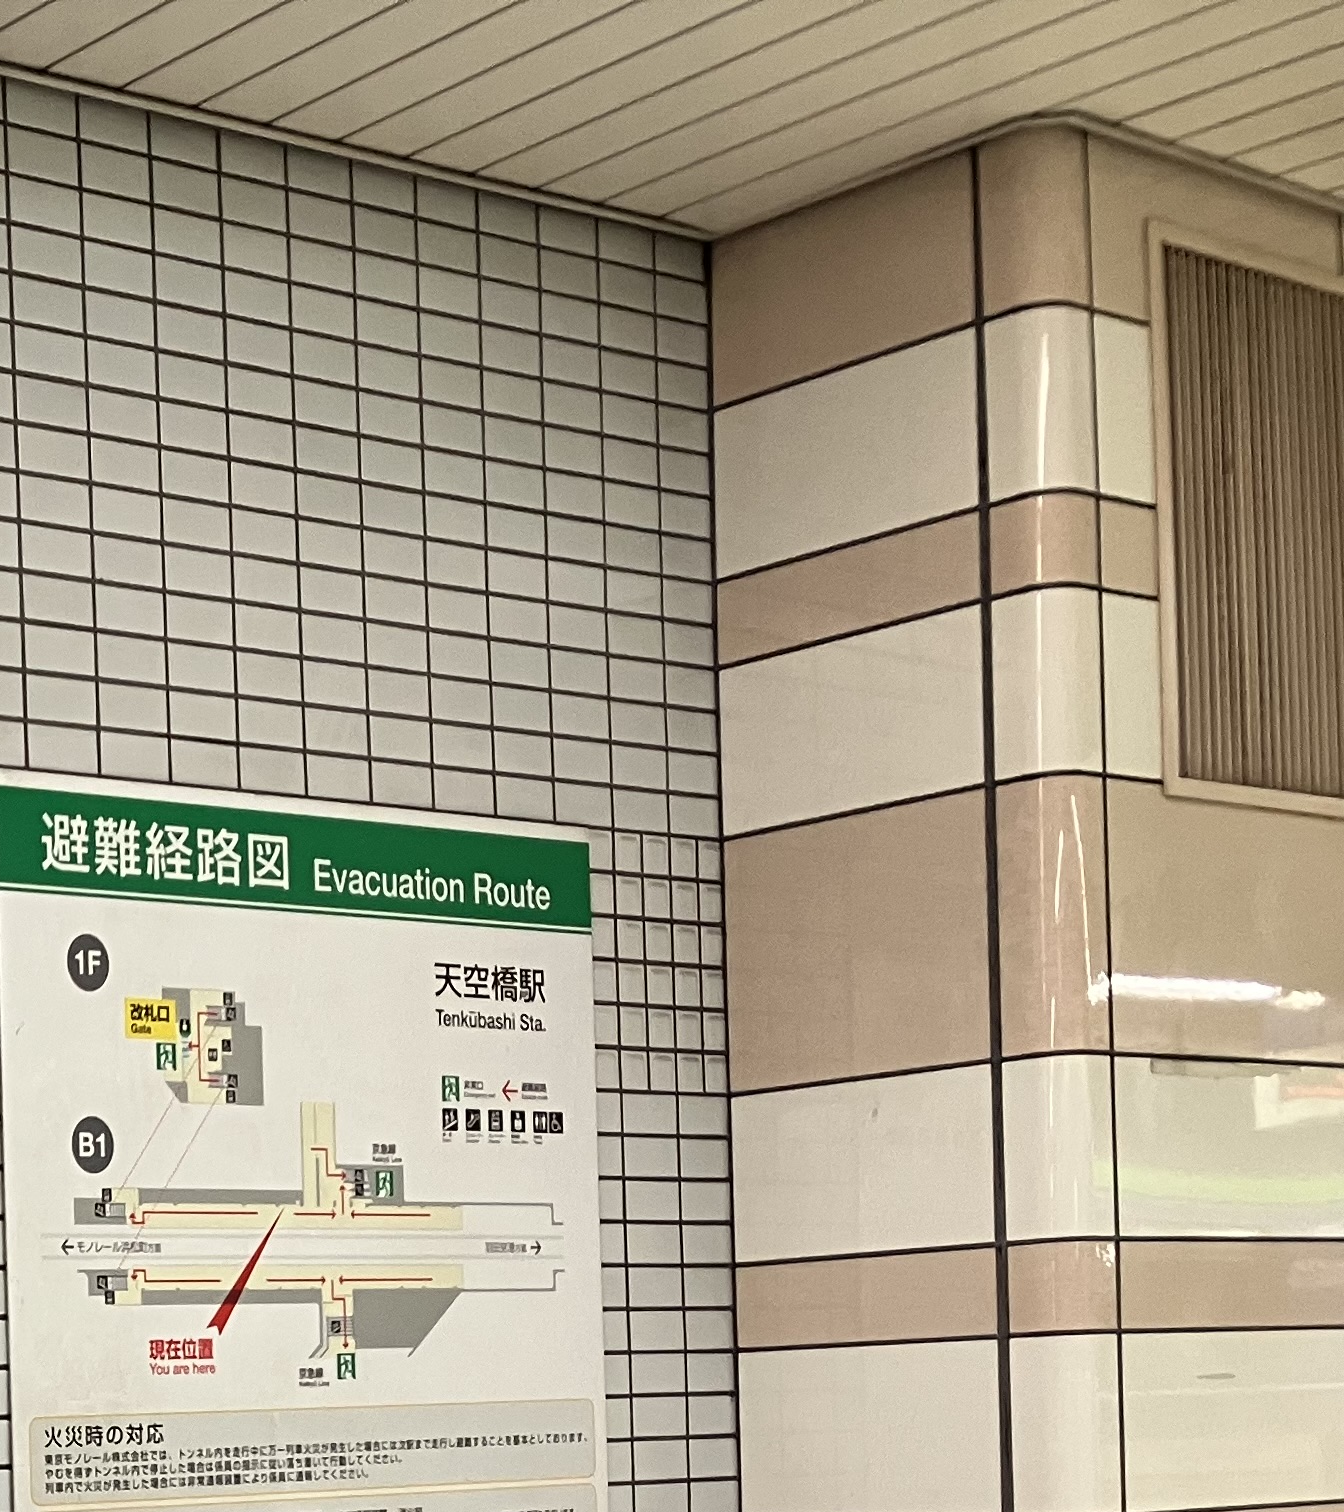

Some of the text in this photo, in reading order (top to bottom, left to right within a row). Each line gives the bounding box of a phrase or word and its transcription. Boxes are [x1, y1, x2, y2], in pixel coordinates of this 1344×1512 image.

[41, 811, 551, 911] 避難経路図 Evacuation Route
[74, 949, 102, 976] 1F
[434, 962, 546, 1004] 天空橋駅
[129, 1003, 170, 1023] 改札口
[436, 1009, 546, 1033] Tenkūbashi Sta.
[79, 1132, 106, 1158] B1
[149, 1338, 214, 1360] 現在位置
[149, 1363, 216, 1375] You are here
[44, 1423, 164, 1447] 火災時の対応
